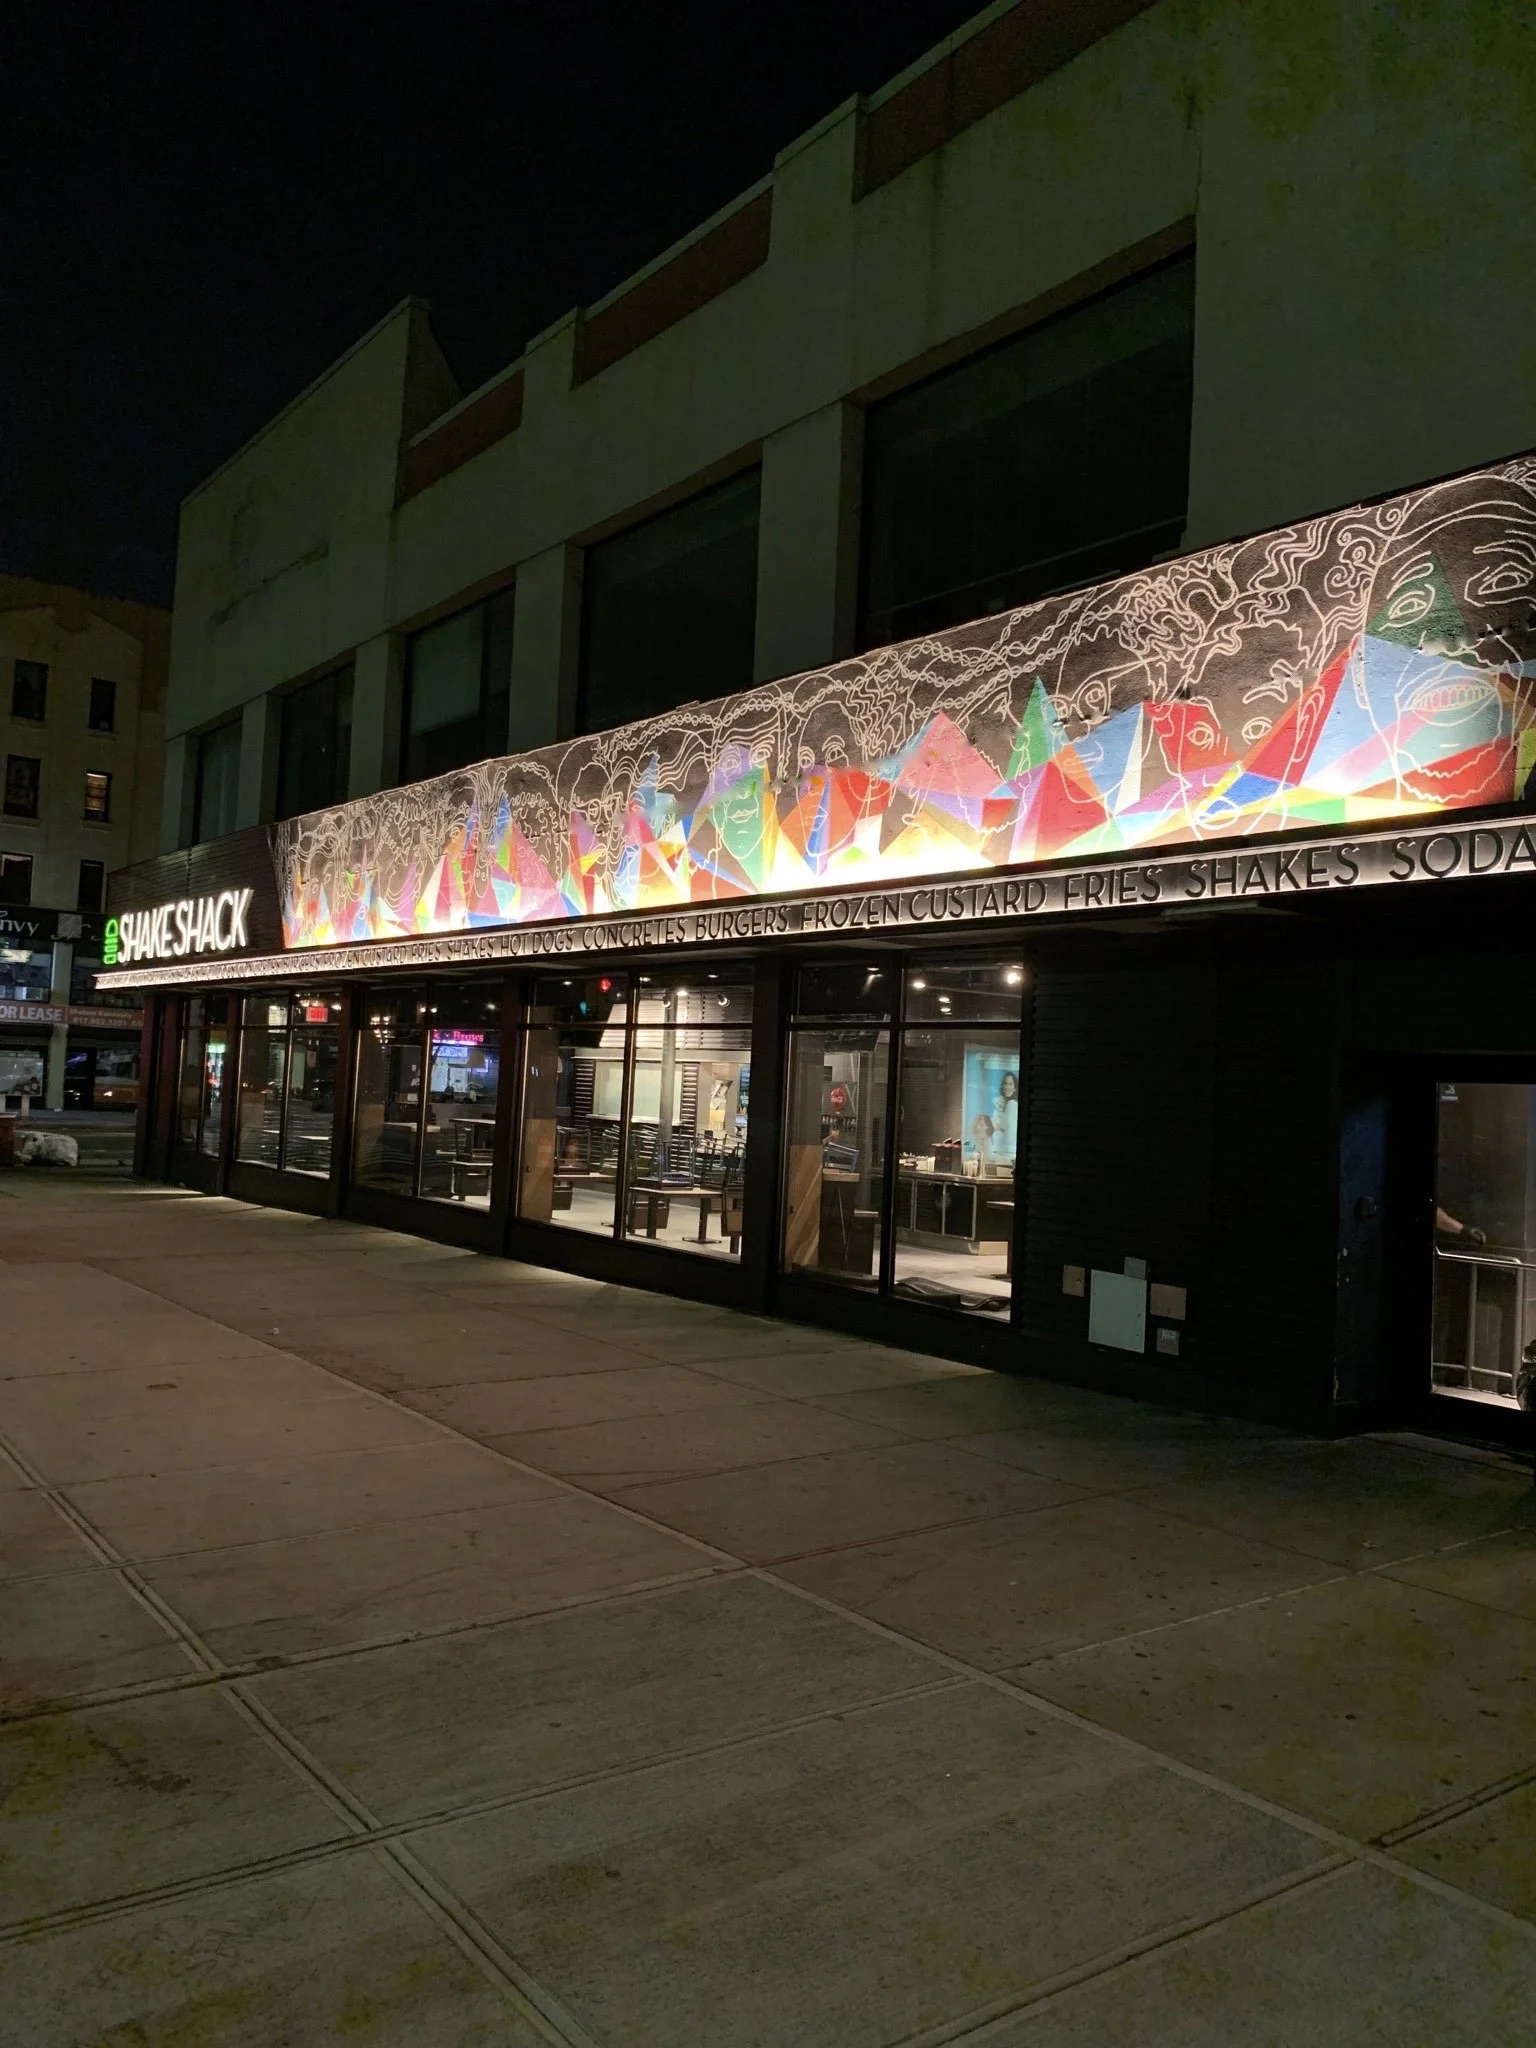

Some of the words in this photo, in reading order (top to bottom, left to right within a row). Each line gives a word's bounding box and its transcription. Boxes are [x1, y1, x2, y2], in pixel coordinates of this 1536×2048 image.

[363, 945, 406, 967] CUSTARD
[411, 942, 442, 963] FRIES
[447, 938, 495, 960] SHAKES
[501, 933, 531, 956] HOT
[532, 929, 574, 954] DOGS
[582, 917, 687, 951] CONCRETES
[695, 905, 791, 941] BURGERS
[800, 893, 902, 931] FROZEN
[908, 879, 1048, 921] CUSTARD
[1064, 864, 1163, 909] FRIES
[1184, 843, 1360, 899] SHAKES
[1388, 823, 1536, 880] SODA
[0, 910, 39, 937] nvy
[118, 904, 176, 963] SHAKE
[173, 888, 252, 956] SHACK
[20, 1006, 62, 1021] LEASE
